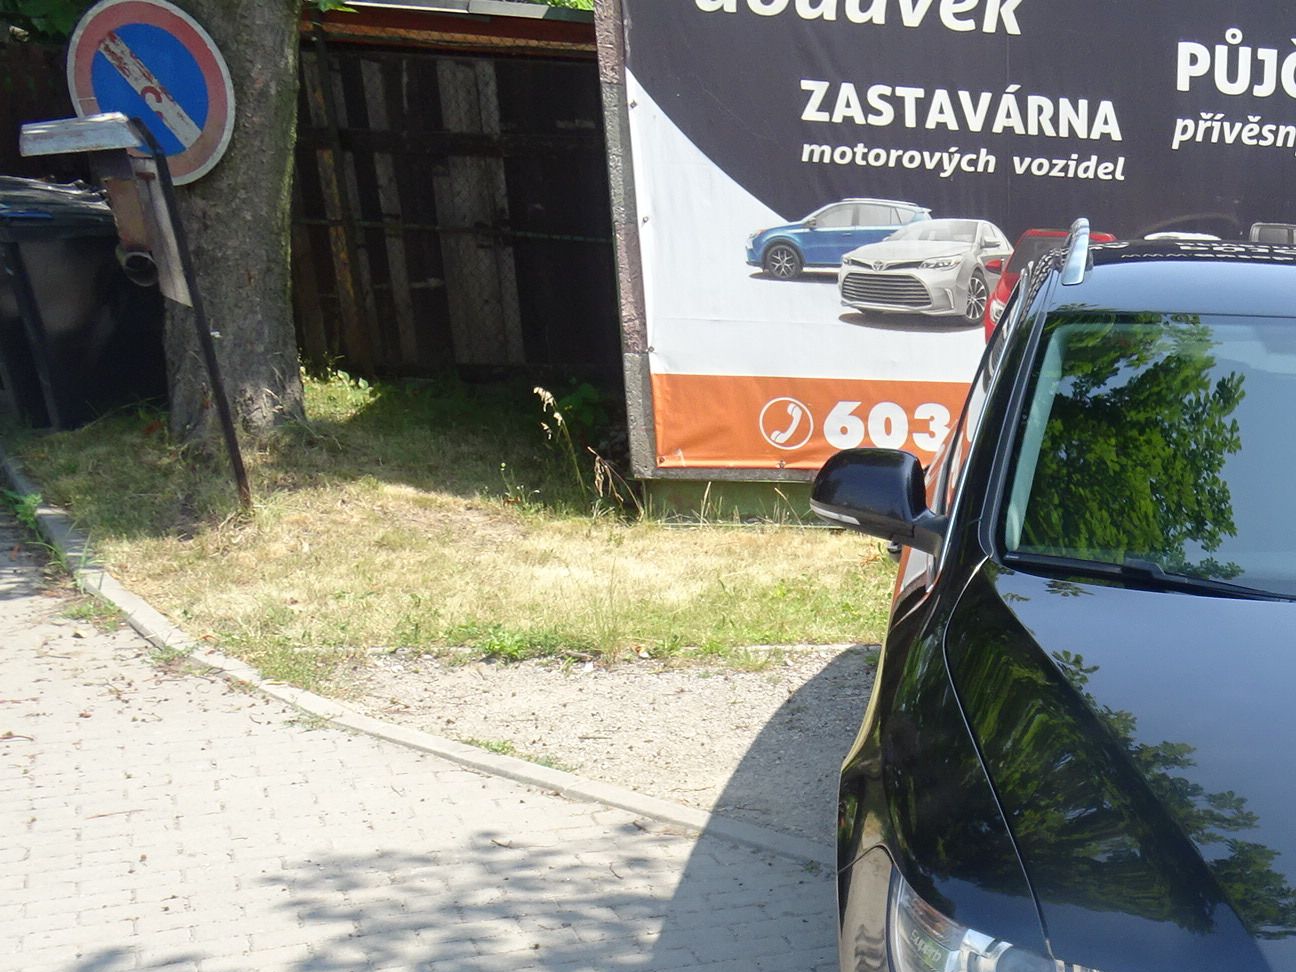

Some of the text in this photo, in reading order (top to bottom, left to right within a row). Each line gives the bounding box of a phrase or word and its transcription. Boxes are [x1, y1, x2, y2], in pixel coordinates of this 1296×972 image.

[800, 79, 1123, 141] ZASTAVÁRNA
[801, 142, 1126, 181] motorových vozidel
